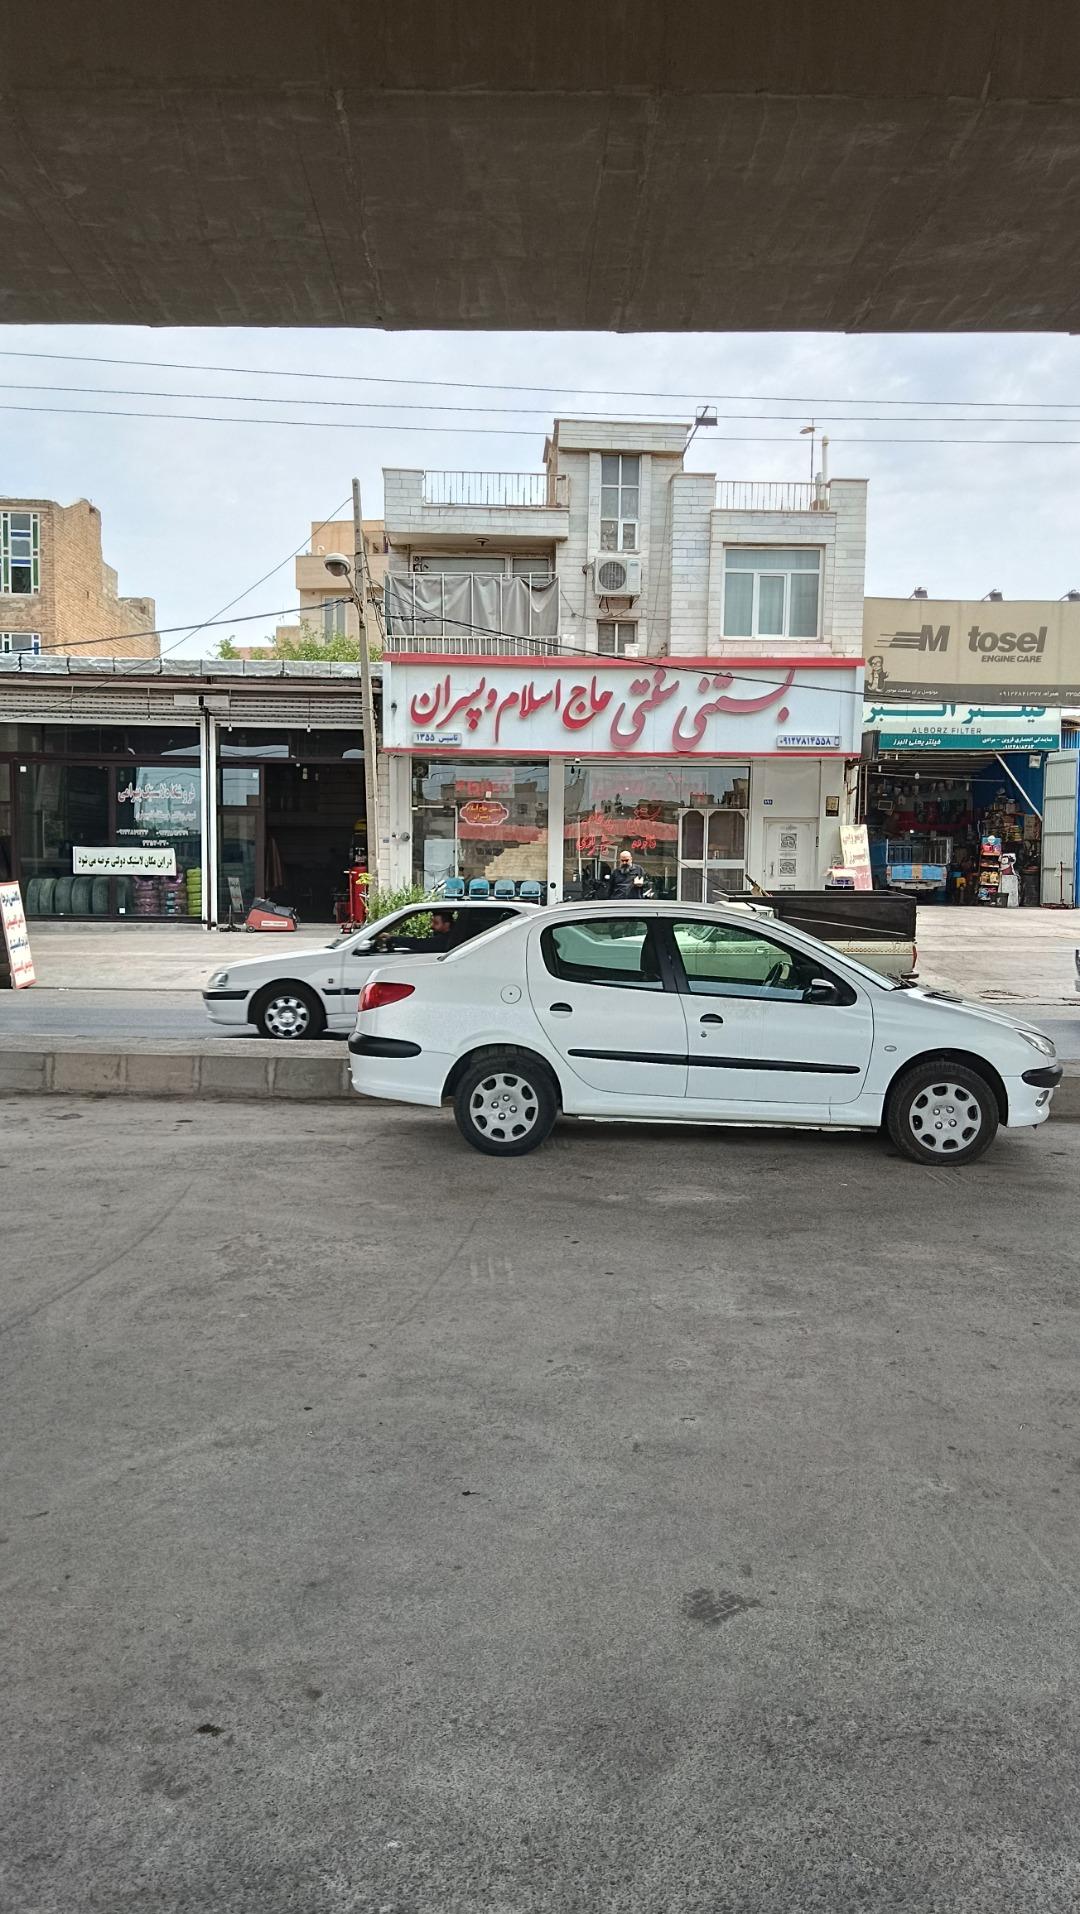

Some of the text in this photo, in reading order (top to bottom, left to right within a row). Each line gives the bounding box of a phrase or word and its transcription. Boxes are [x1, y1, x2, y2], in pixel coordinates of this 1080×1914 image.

[967, 626, 1048, 653] tosel
[981, 655, 1042, 663] ENGINE CARE
[410, 674, 486, 732] پسران
[493, 677, 562, 744] اسلام
[561, 674, 614, 730] حاج
[609, 667, 680, 750] سنتی
[671, 667, 796, 752] بستنی
[416, 733, 435, 742] ۱۳۵۵
[111, 855, 125, 868] دولتی
[126, 855, 143, 867] لاستیک
[144, 855, 156, 868] مکان
[157, 856, 166, 868] این
